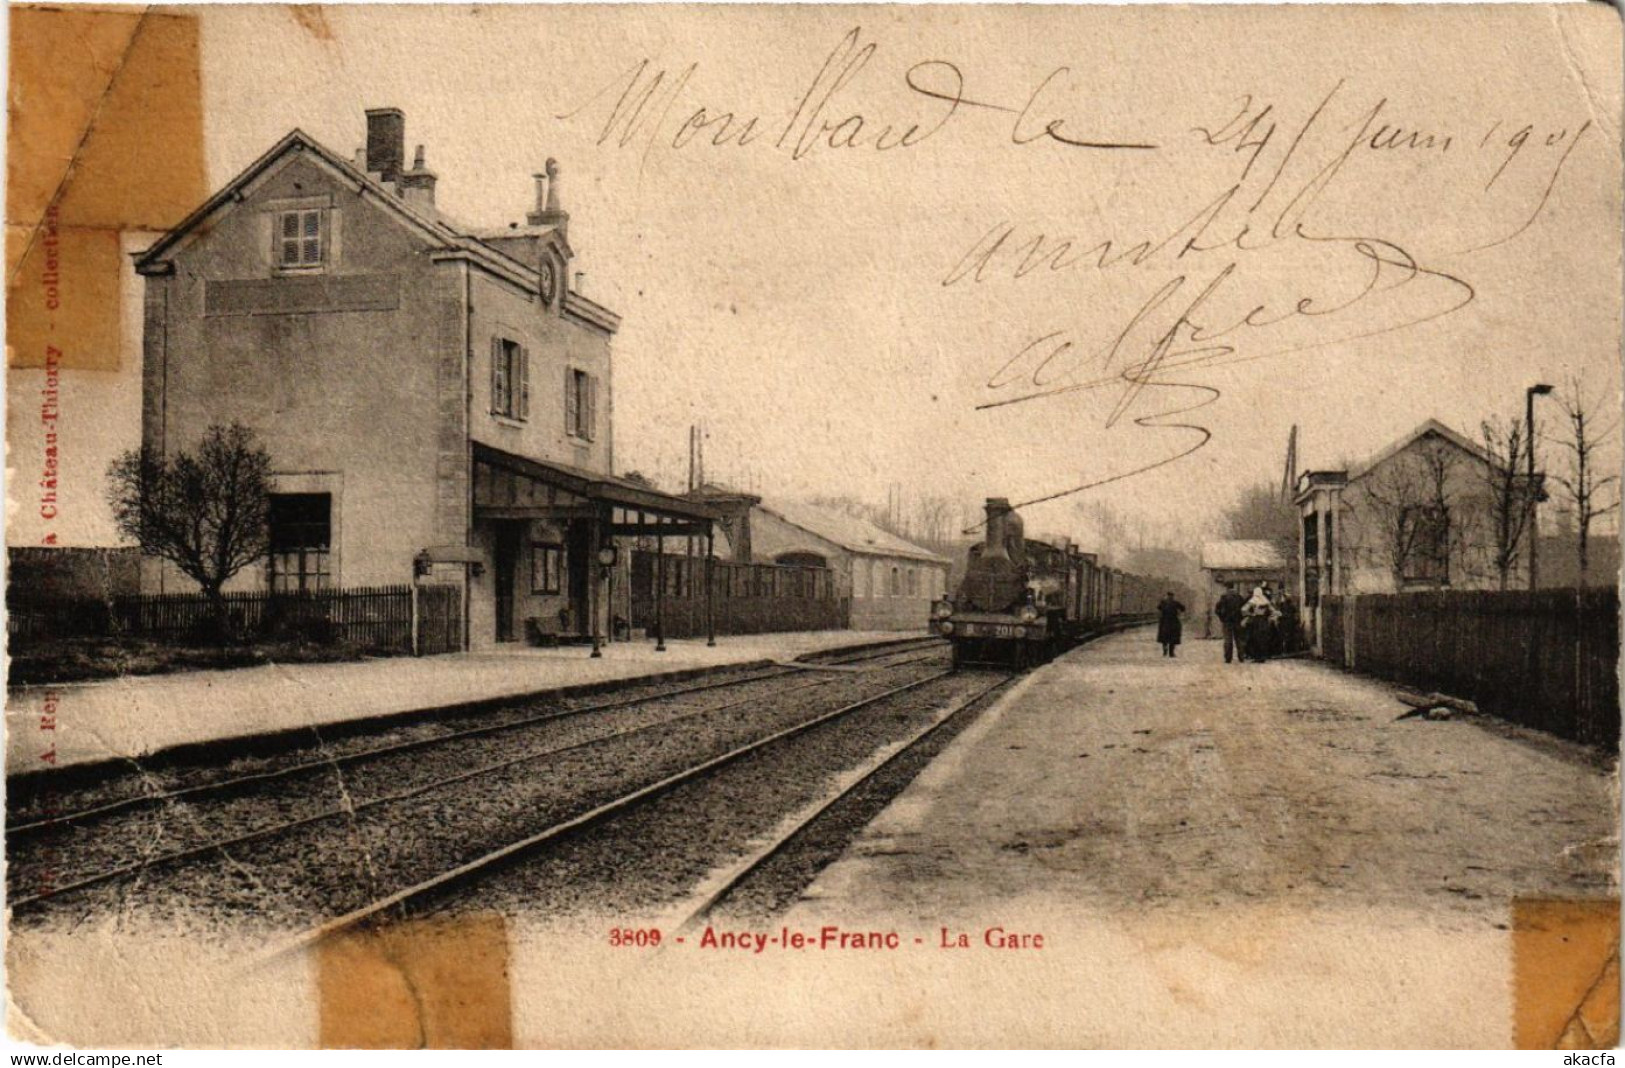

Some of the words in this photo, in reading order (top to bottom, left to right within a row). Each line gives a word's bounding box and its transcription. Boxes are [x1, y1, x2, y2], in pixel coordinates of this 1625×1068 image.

[40, 346, 61, 520] Château-Thierry
[609, 928, 662, 947] 3809
[700, 927, 901, 952] Ancy-le-Franc
[940, 928, 969, 948] La
[984, 927, 1044, 949] Gare
